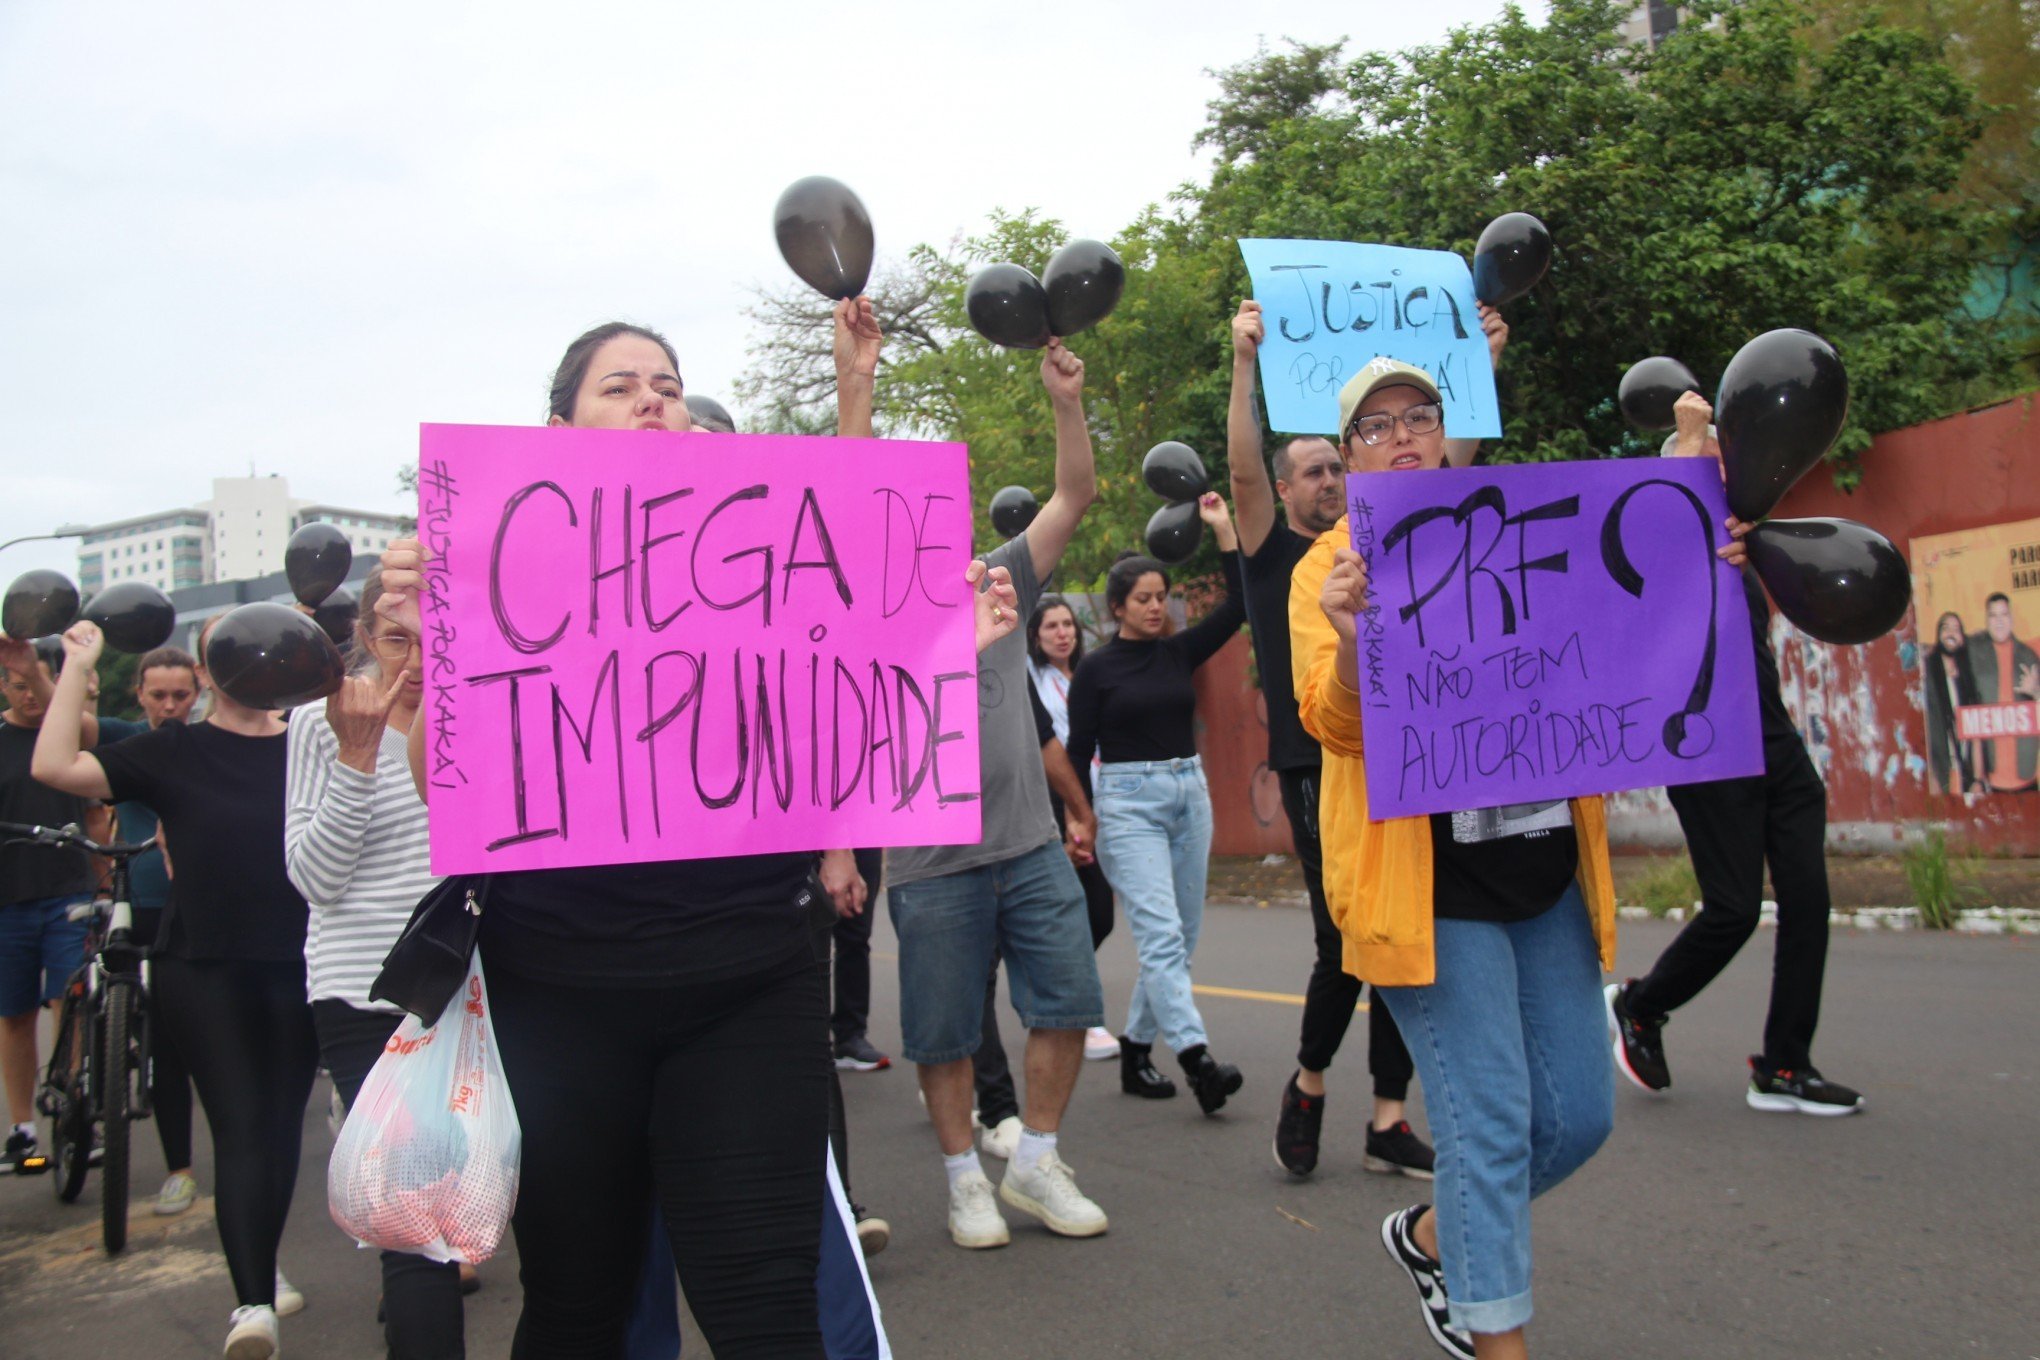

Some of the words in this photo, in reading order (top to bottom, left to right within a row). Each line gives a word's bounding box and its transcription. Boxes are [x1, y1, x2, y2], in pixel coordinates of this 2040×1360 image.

[1270, 264, 1469, 343] JUSTIÇA
[1289, 352, 1344, 399] POR
[489, 480, 853, 654] CHEGA
[873, 488, 957, 619] DE
[1406, 645, 1474, 711] NÃO
[1484, 632, 1589, 692] TEM
[464, 624, 979, 852] IMPUNIDADE
[1962, 704, 2030, 735] MENOS
[452, 1085, 473, 1113] 7kg
